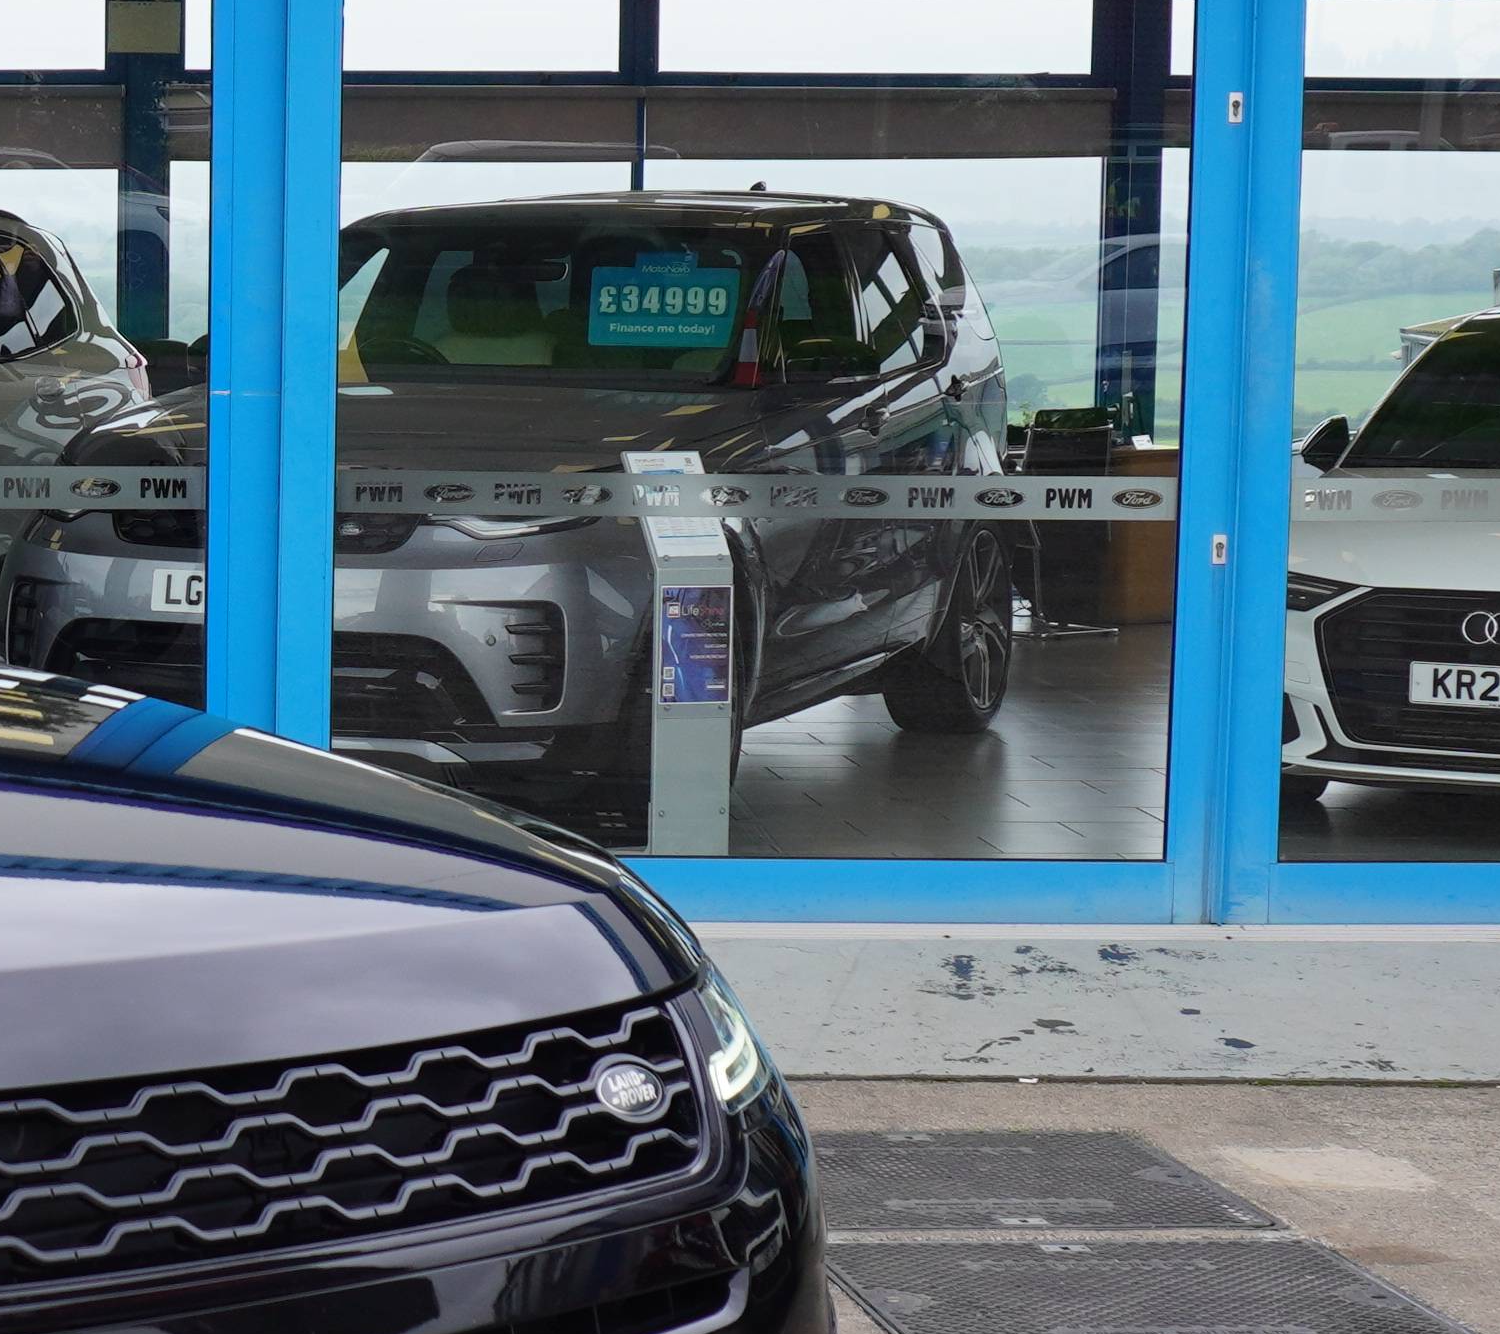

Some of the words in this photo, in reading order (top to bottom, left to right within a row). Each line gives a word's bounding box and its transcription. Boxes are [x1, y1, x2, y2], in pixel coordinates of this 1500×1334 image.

[599, 285, 727, 315] £34999
[609, 323, 654, 333] Finance
[657, 324, 675, 333] me
[678, 323, 715, 335] today!
[3, 477, 50, 499] PWM
[140, 478, 187, 499] PWM
[908, 487, 955, 508] PWM
[1045, 488, 1093, 509] PWM
[1305, 489, 1352, 510] PWM
[165, 573, 202, 606] LG
[607, 1070, 641, 1093] LAND
[619, 1083, 658, 1108] ROVER
